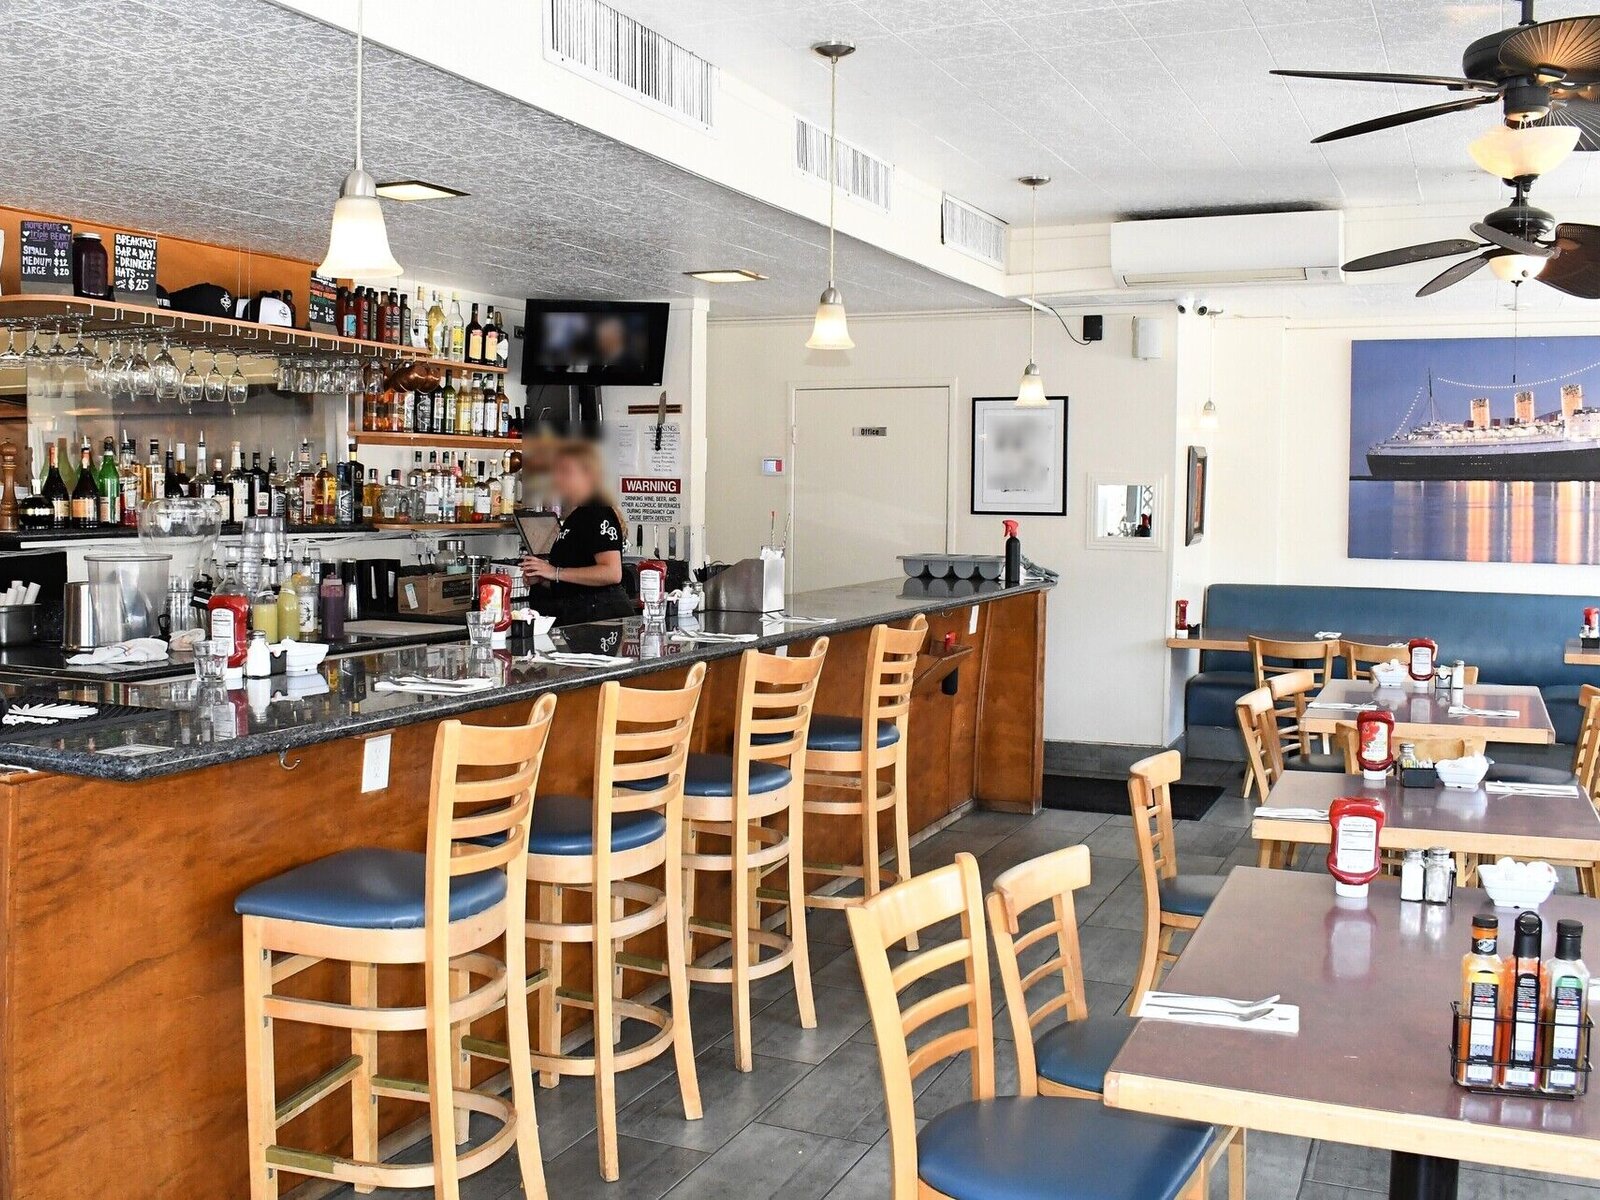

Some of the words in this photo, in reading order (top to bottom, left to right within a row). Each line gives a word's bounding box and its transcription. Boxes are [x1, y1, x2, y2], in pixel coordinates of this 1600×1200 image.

[116, 234, 157, 250] BREAKFAST
[23, 245, 48, 256] SMALL
[115, 245, 131, 257] BAR
[139, 249, 154, 261] DAY
[23, 256, 52, 267] MEDIUM
[54, 258, 69, 267] $12
[120, 257, 152, 271] DRINKER
[23, 266, 47, 275] LARGE
[54, 267, 70, 276] $20
[115, 267, 136, 278] HATS
[128, 278, 149, 291] $25
[626, 480, 677, 492] WARNING
